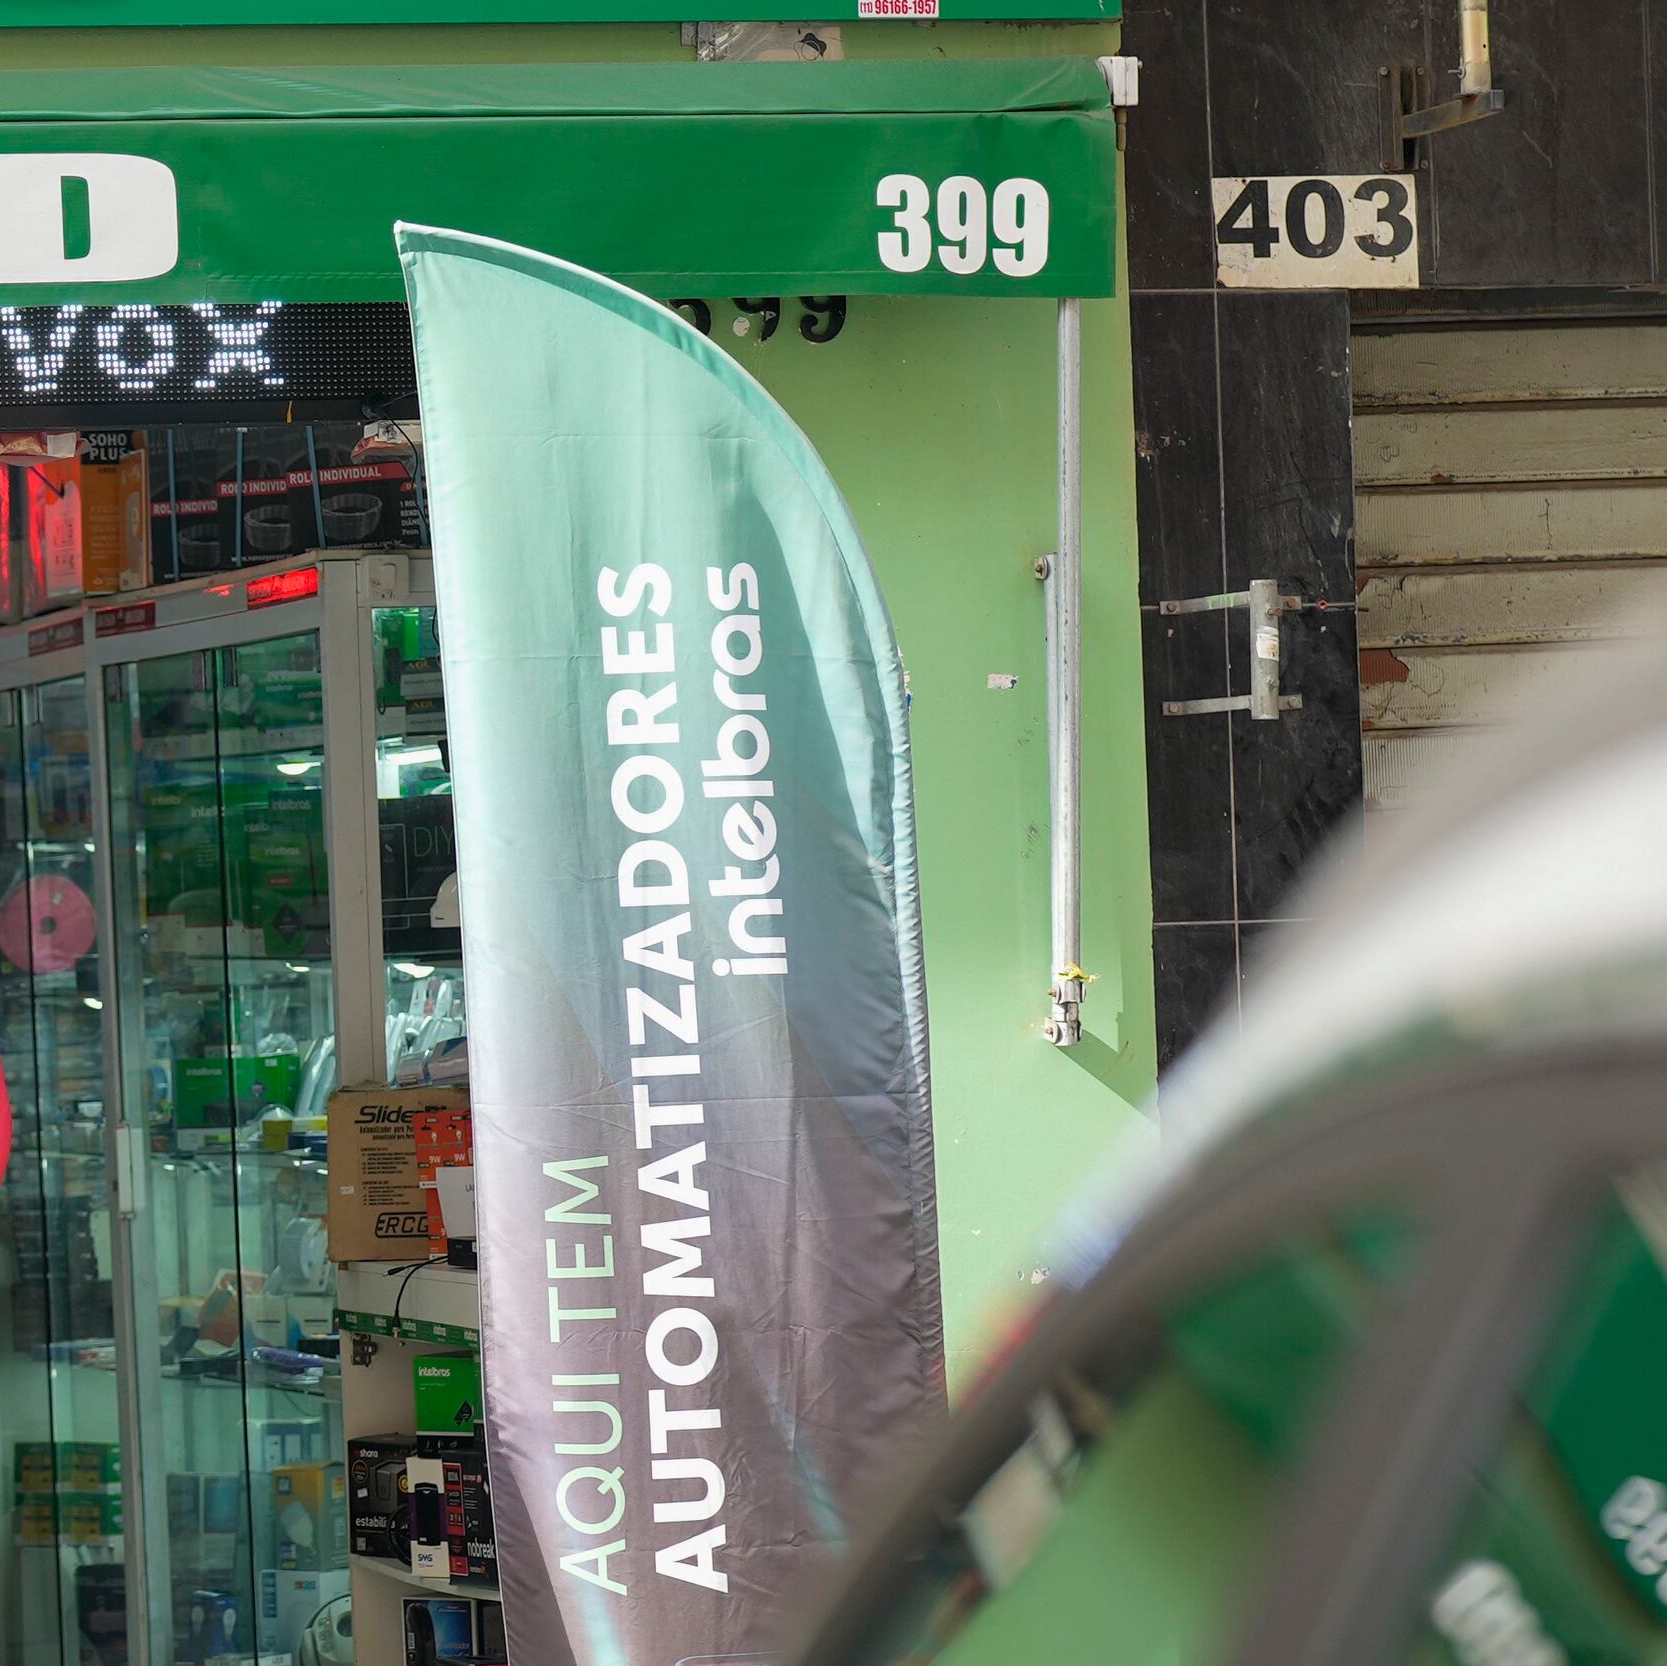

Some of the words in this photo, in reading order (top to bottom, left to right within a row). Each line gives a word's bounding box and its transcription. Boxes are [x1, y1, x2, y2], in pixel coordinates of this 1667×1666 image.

[875, 0, 936, 14] 96166-1957
[875, 173, 1050, 279] 399
[1216, 178, 1413, 260] 403
[89, 433, 127, 447] SOHO
[89, 448, 127, 461] PLUS
[319, 465, 382, 481] INDIVIDUAL
[701, 561, 788, 978] intelbras
[597, 561, 729, 1594] AUTOMATIZADORES
[542, 1153, 618, 1345] TEM
[418, 1366, 451, 1378] intelbras
[553, 1373, 628, 1597] AQUI
[355, 1515, 389, 1528] estabili
[467, 1537, 495, 1559] nobreak
